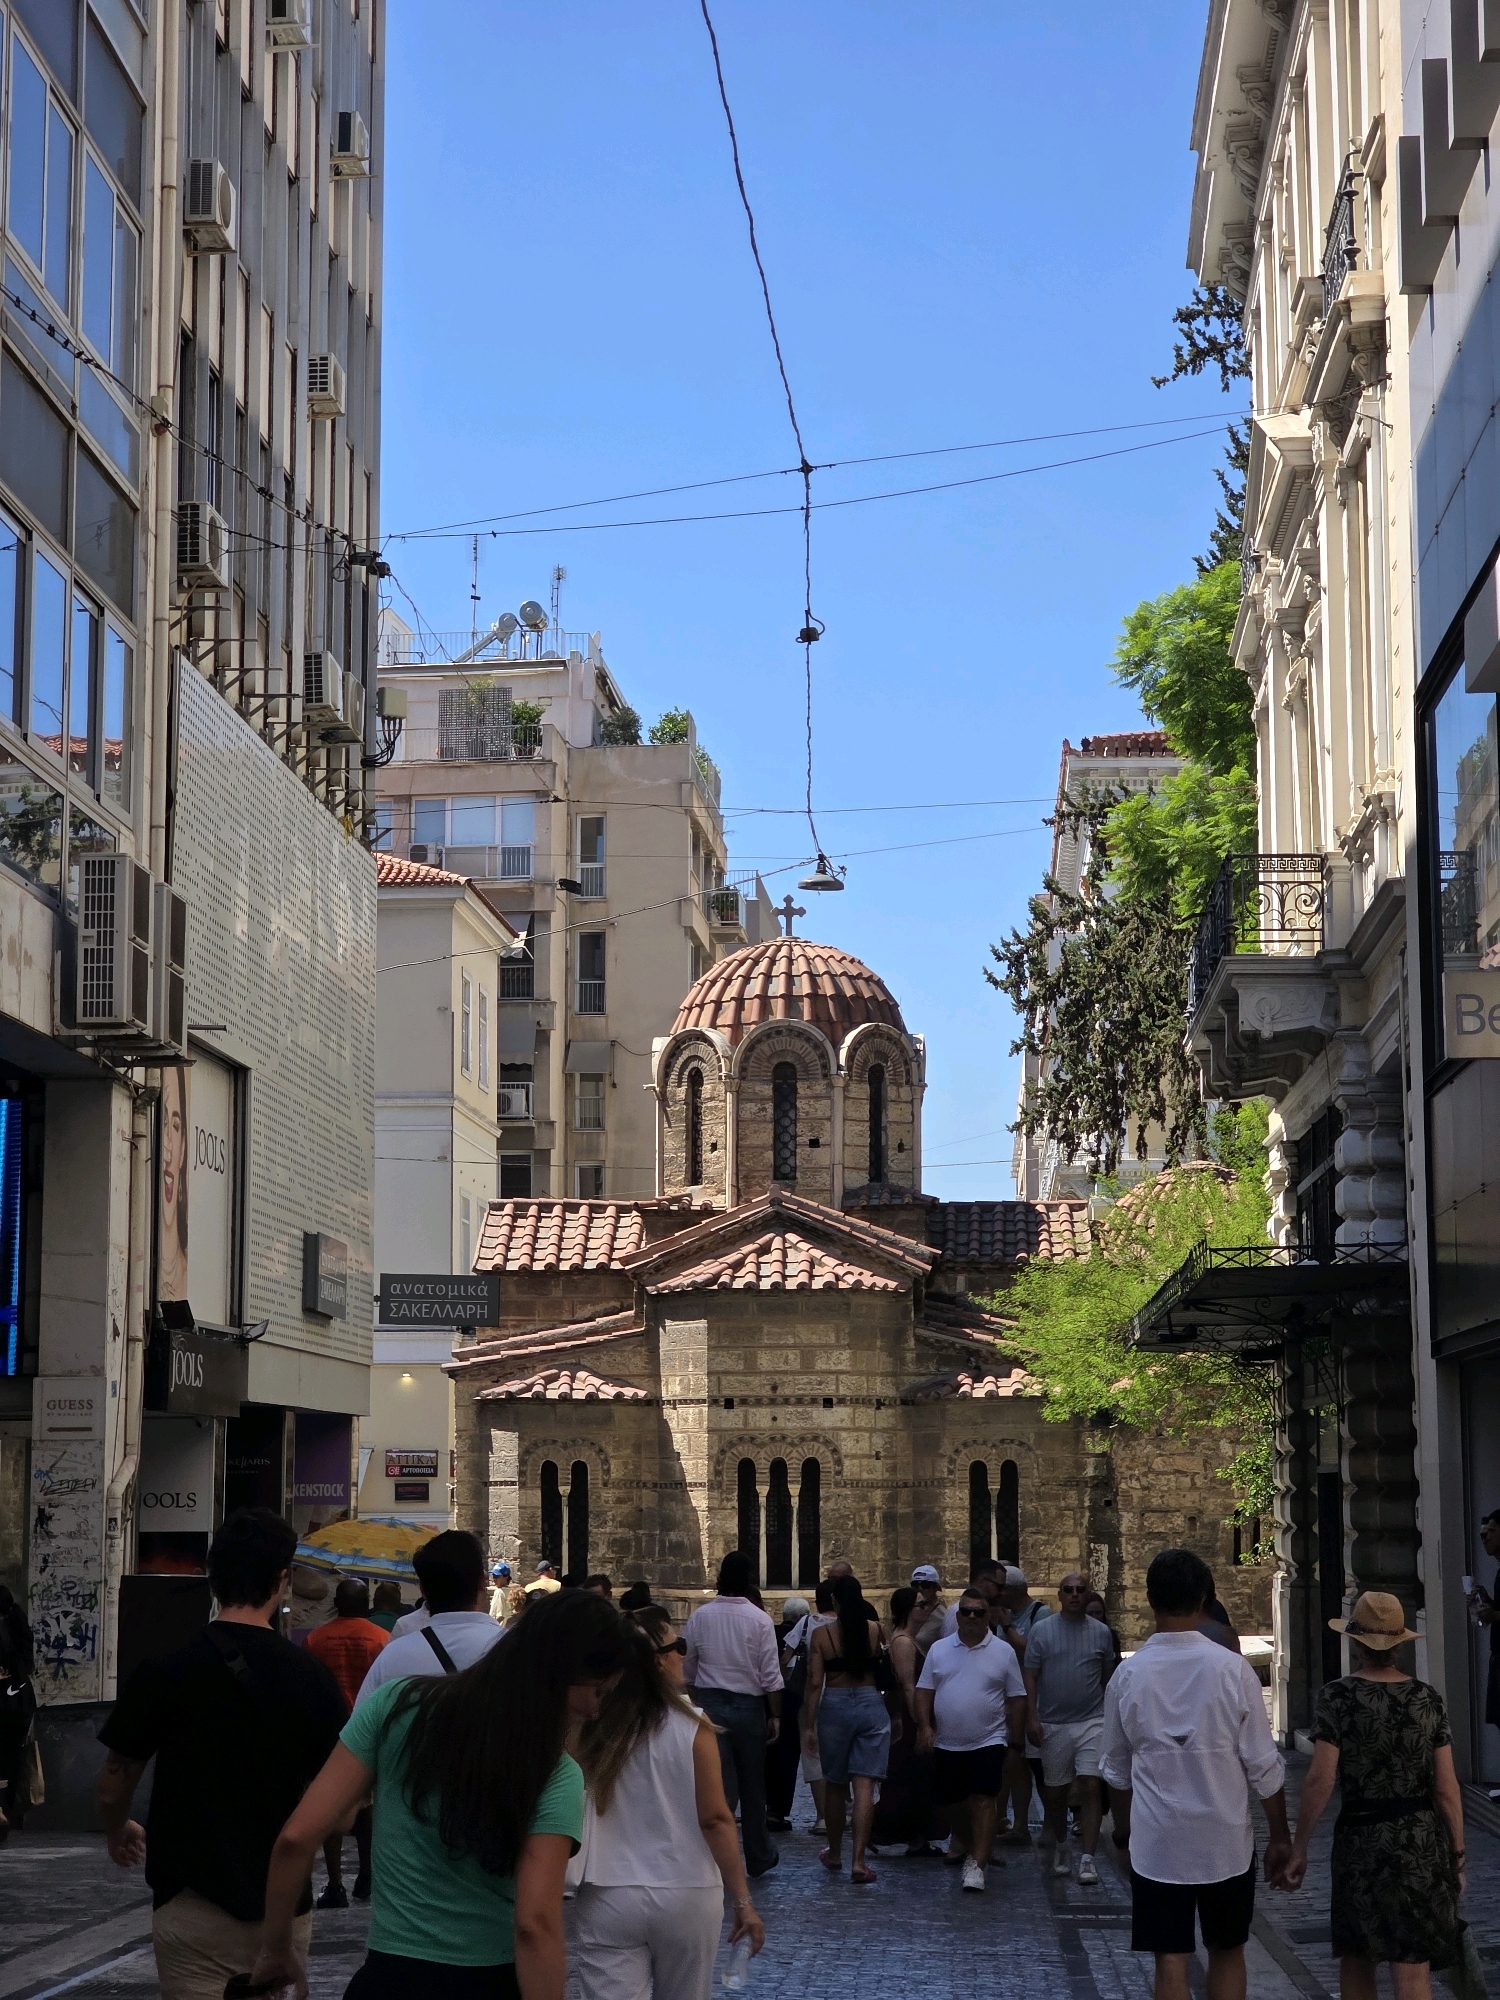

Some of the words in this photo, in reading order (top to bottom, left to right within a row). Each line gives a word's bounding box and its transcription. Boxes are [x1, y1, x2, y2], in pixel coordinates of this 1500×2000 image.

[1455, 993, 1500, 1035] Be
[193, 1125, 225, 1175] JOOLS
[390, 1281, 489, 1299] ανατομικά
[389, 1302, 488, 1319] ΣΑΚΕΛΛΑΡΗ
[170, 1349, 204, 1393] JOOLS
[46, 1399, 94, 1411] GUESS
[293, 1483, 345, 1497] KENSTOCK
